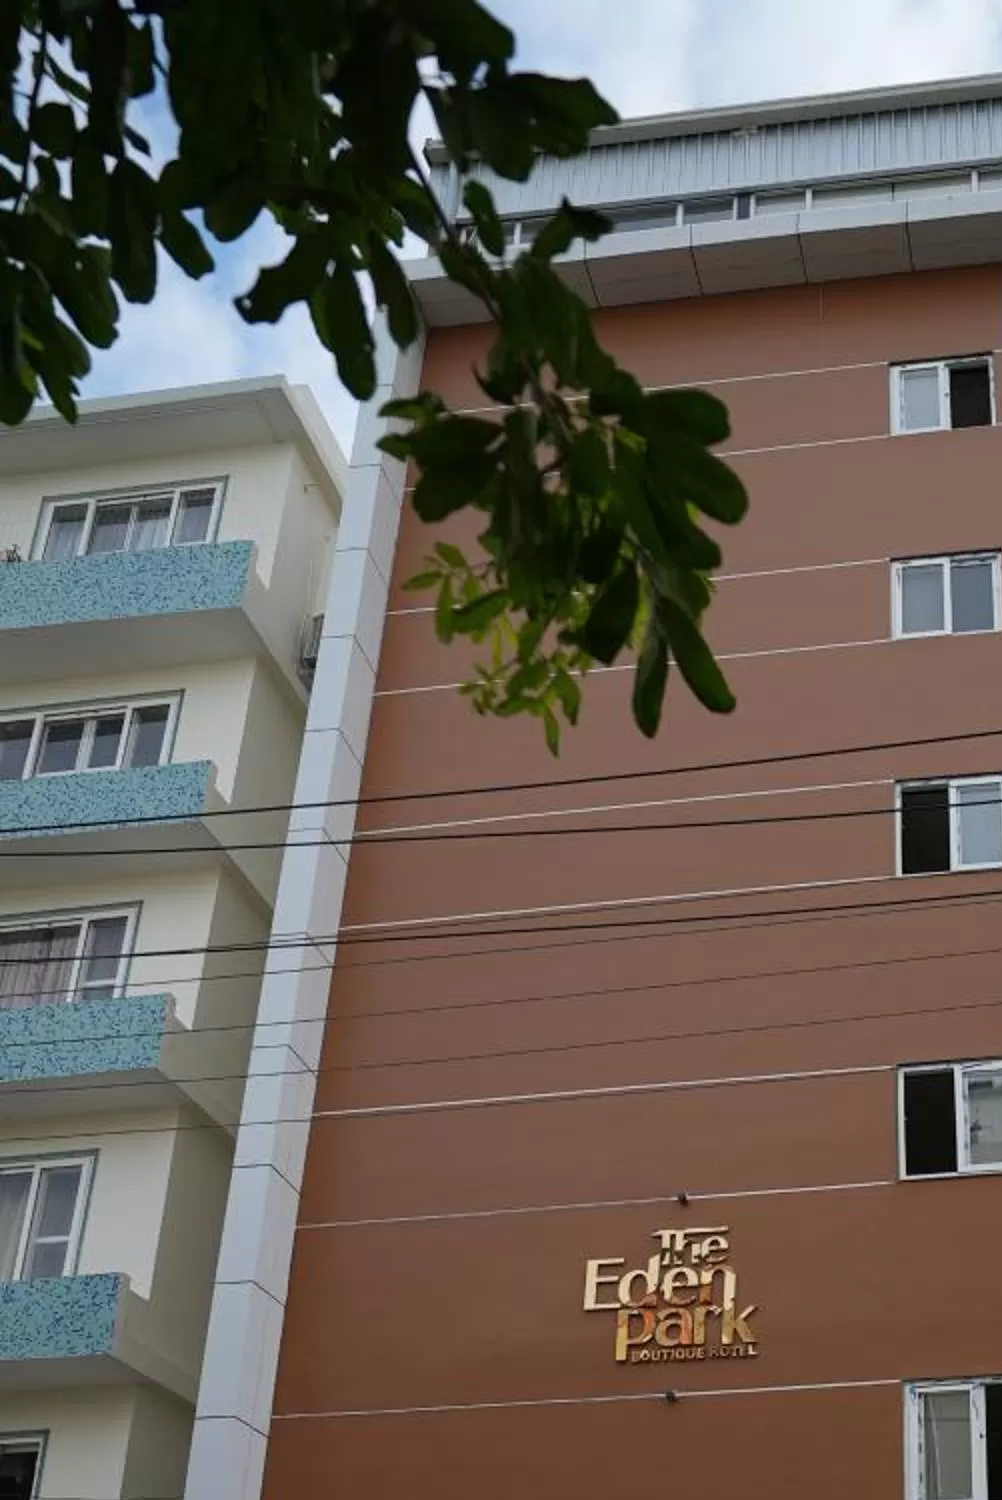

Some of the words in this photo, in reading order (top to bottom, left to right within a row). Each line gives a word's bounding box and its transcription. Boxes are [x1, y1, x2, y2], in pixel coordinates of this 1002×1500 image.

[652, 1226, 729, 1265] The
[583, 1253, 737, 1311] Eden
[631, 1347, 705, 1362] BOUTIQUE
